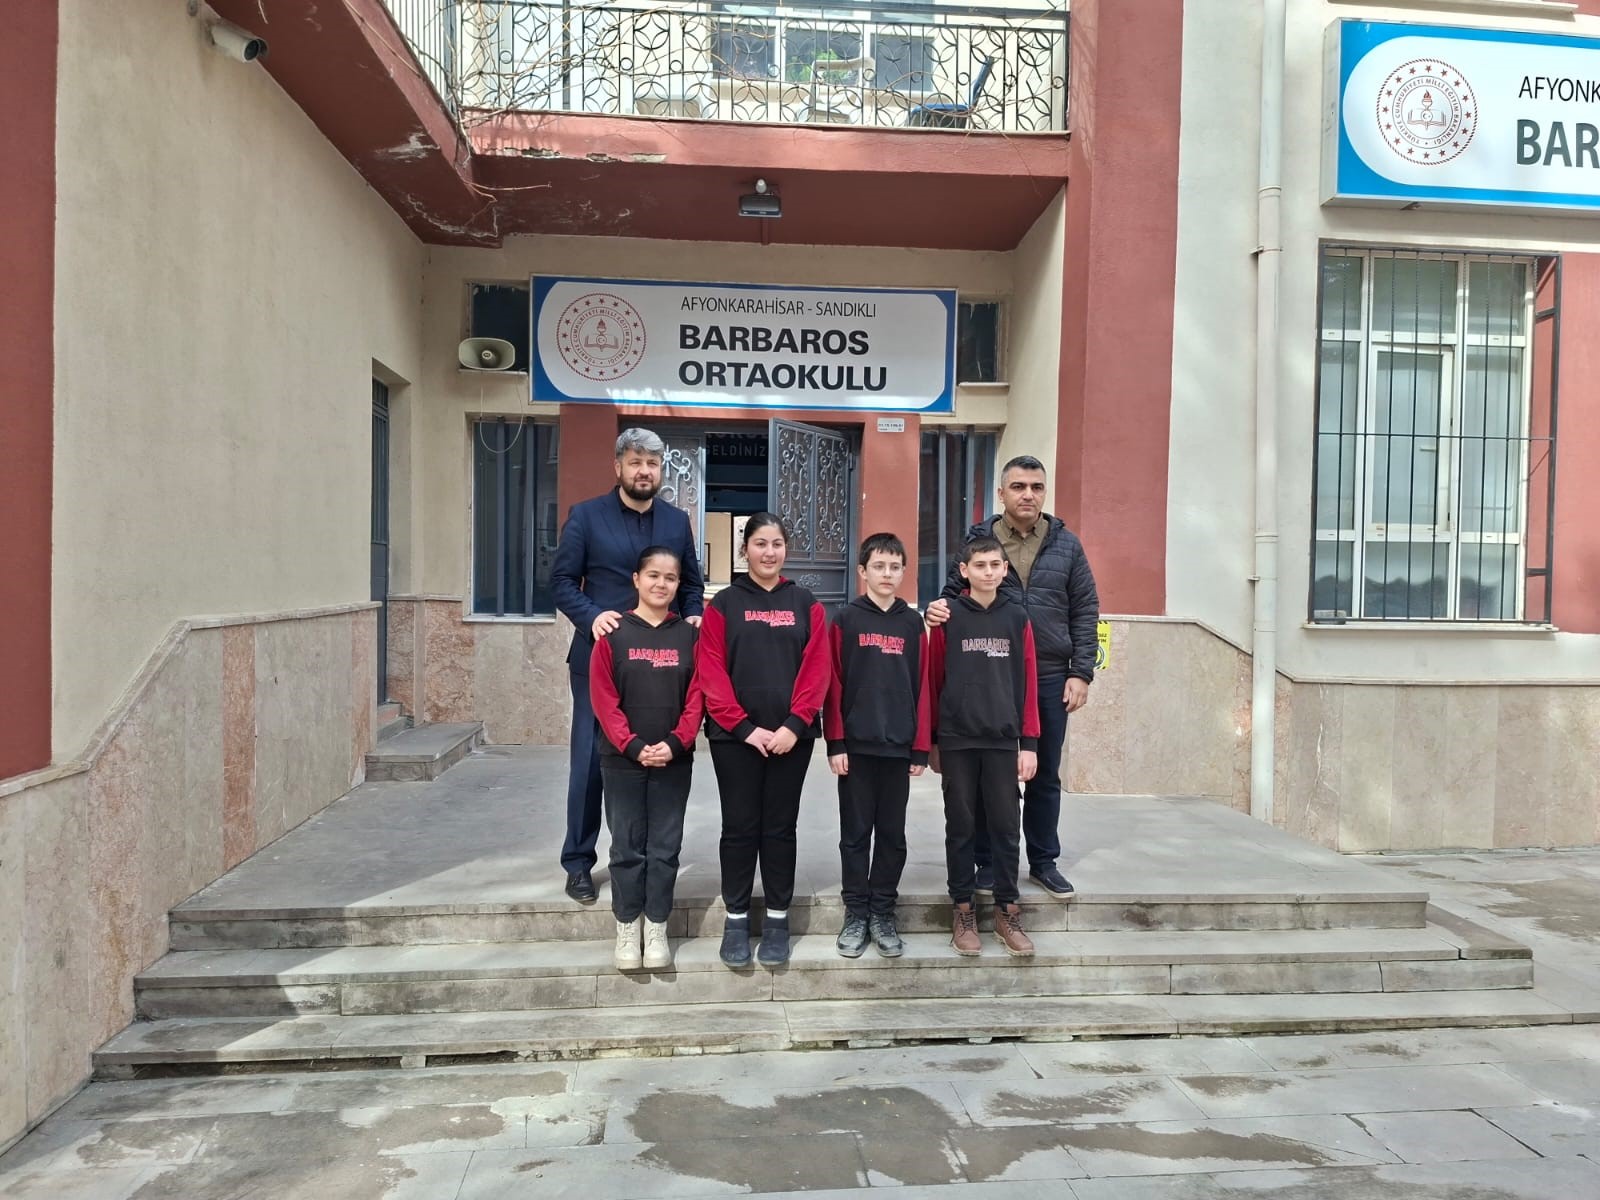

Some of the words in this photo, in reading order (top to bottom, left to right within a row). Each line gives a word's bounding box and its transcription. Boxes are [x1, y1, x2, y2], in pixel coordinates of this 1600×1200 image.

[1518, 75, 1600, 103] AFYONK
[1516, 119, 1600, 169] BAR
[680, 296, 804, 316] AFYONKARAHİSAR
[815, 301, 877, 317] SANDIKLI
[680, 323, 869, 355] BARBAROS
[679, 360, 887, 391] ORTAOKULU
